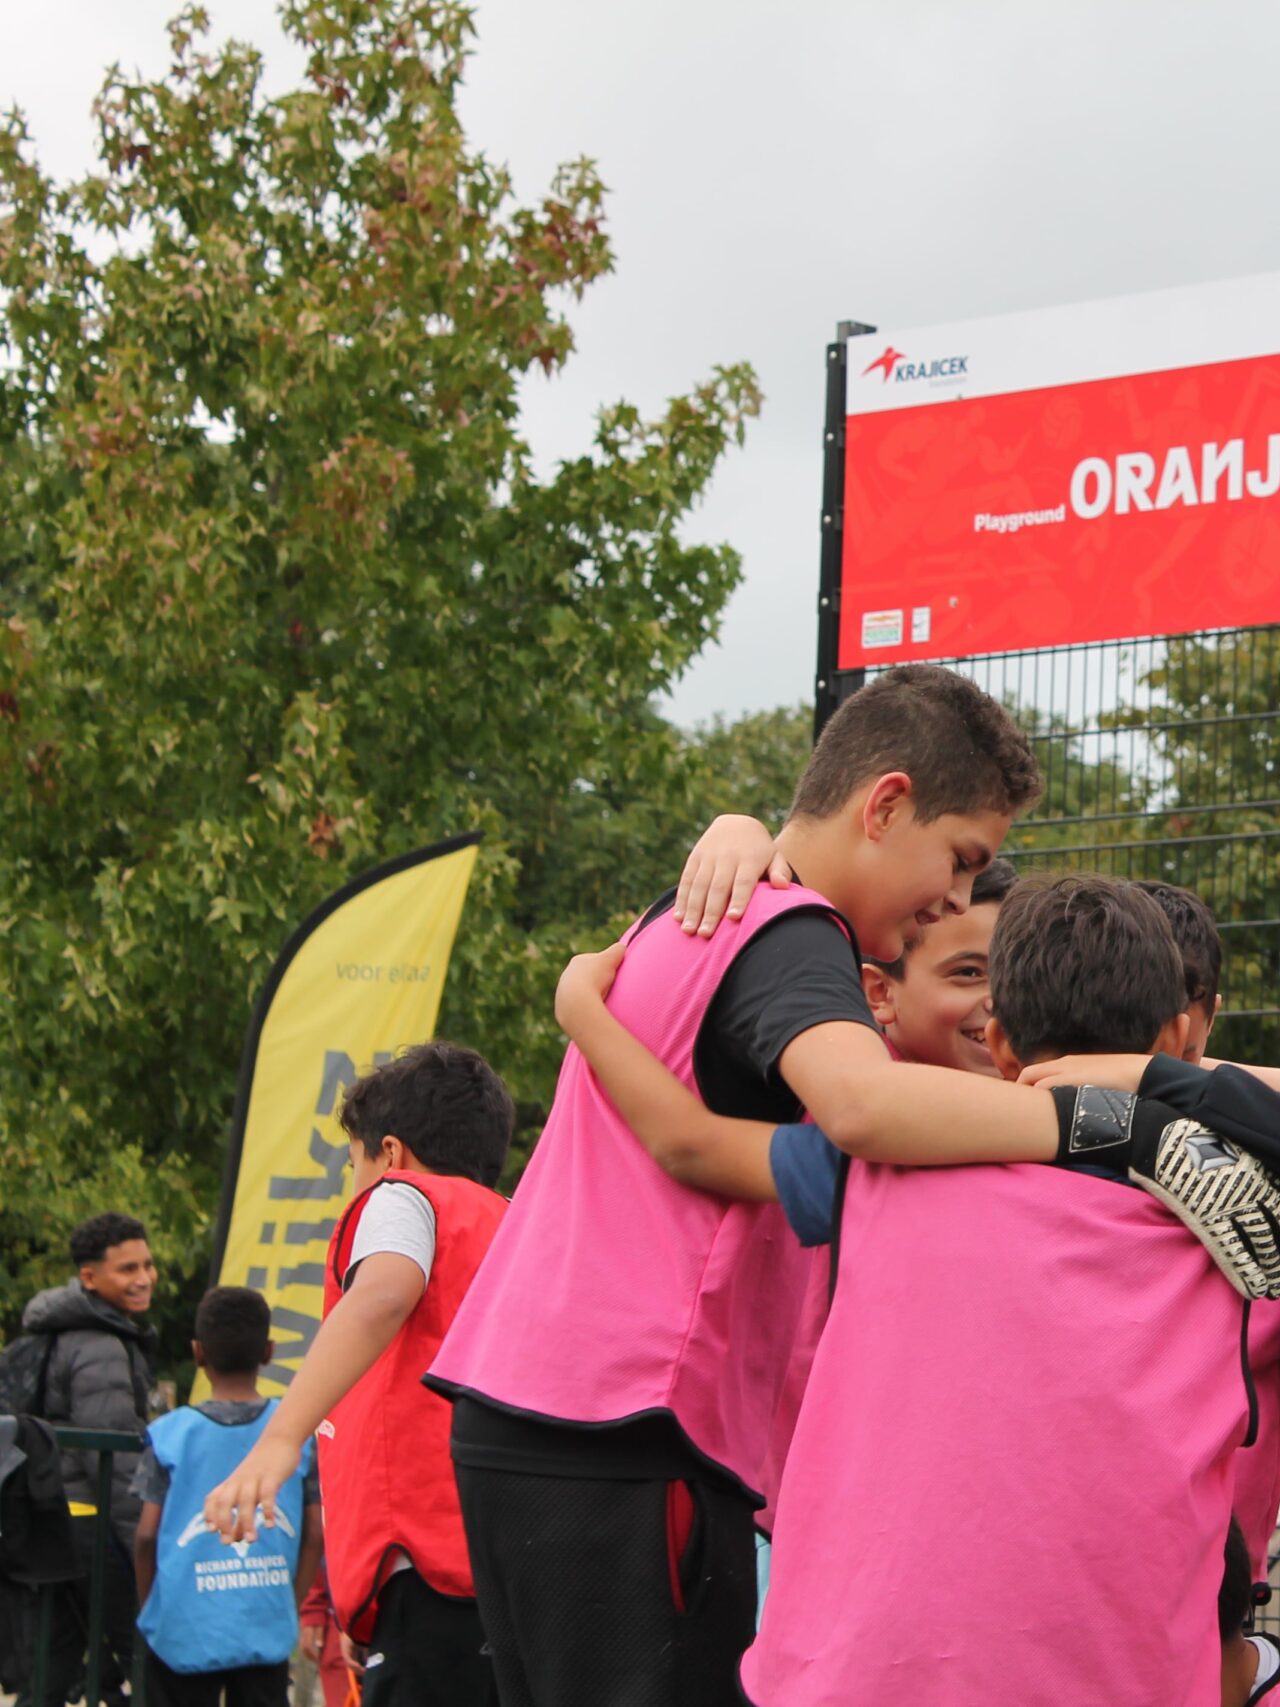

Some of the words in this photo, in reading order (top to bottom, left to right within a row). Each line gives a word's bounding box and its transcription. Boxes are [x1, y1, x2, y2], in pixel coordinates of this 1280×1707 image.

[895, 356, 968, 382] KRAJICEK
[974, 504, 1066, 534] Playground
[335, 962, 384, 982] voor
[195, 1559, 242, 1573] RICHARD
[196, 1569, 290, 1592] FOUNDATION
